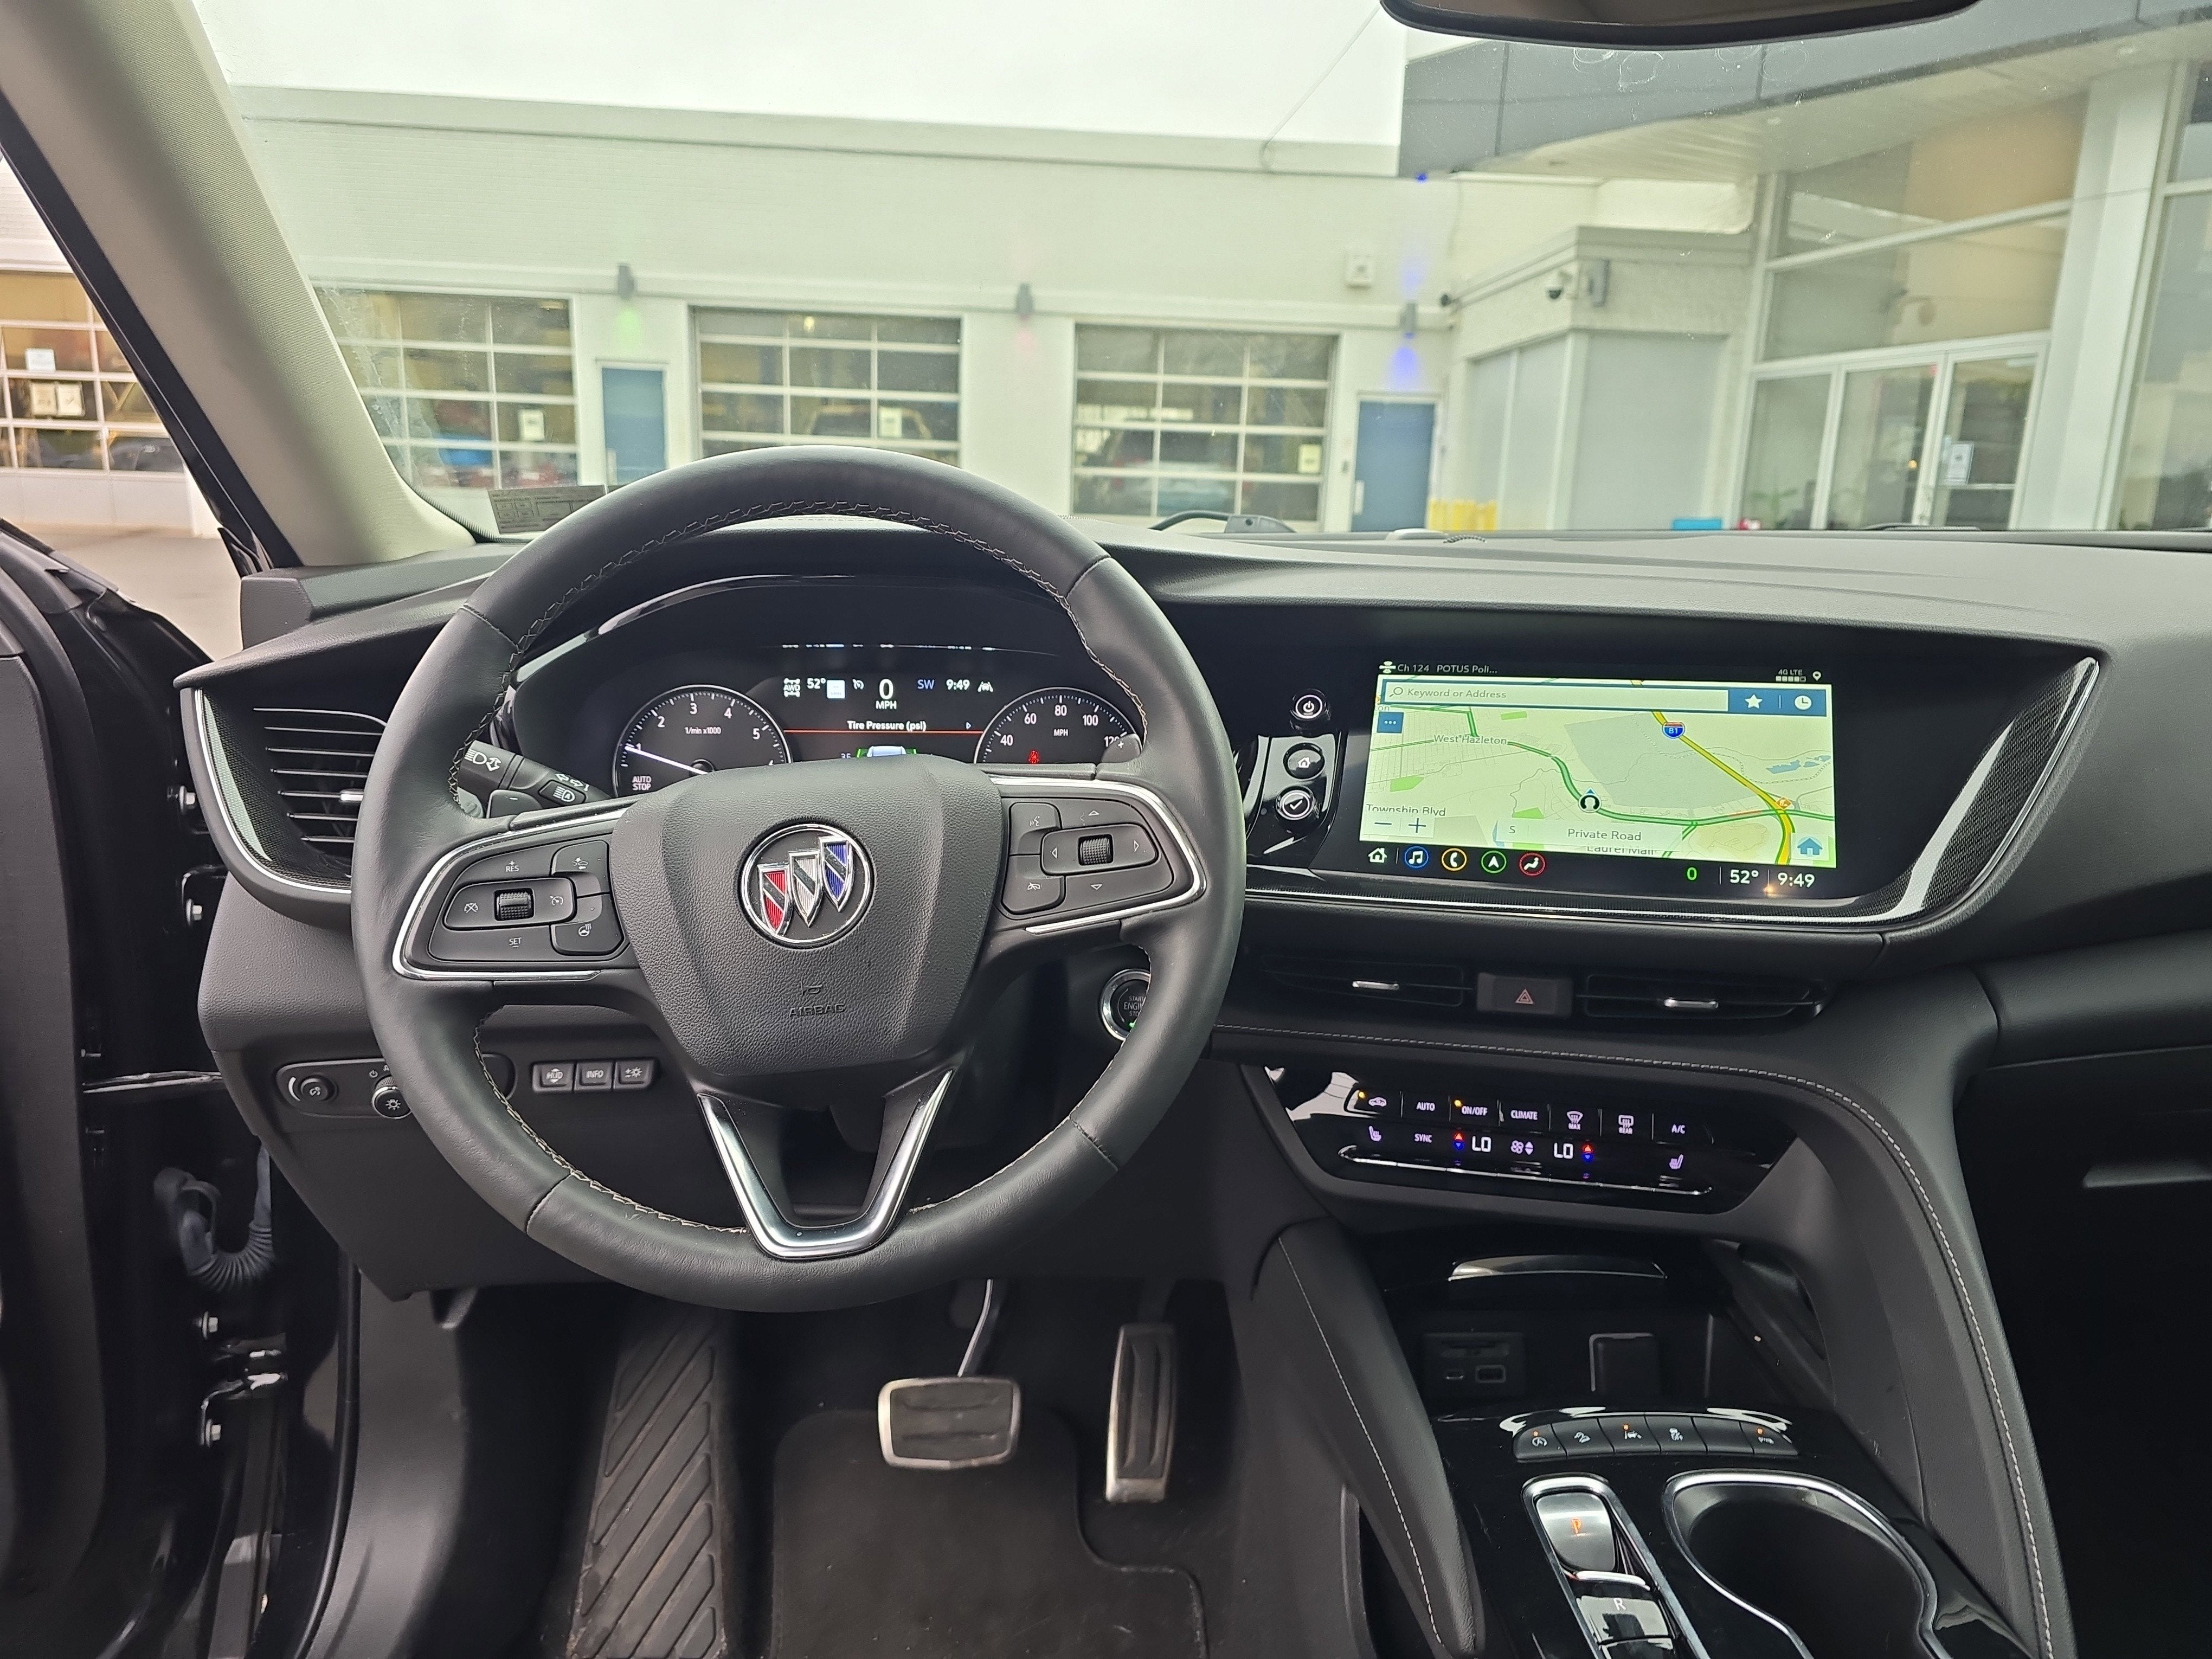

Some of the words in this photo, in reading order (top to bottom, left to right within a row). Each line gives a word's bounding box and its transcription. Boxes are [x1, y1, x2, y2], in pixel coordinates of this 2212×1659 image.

[1398, 664, 1409, 672] Ch
[1413, 664, 1430, 672] 124
[1437, 665, 1469, 673] POTUS
[879, 679, 894, 699] 0
[917, 679, 935, 690] SW
[946, 679, 970, 691] 9:49
[1407, 689, 1451, 699] Keyword
[1465, 690, 1507, 698] Address
[689, 703, 697, 715] 3
[876, 701, 897, 710] MPH
[1054, 705, 1067, 716] 80
[724, 708, 732, 719] 4
[1024, 713, 1037, 724] 60
[657, 716, 665, 728] 2
[847, 720, 865, 730] Tire
[866, 721, 905, 730] Pressure
[906, 721, 927, 732] (psi)
[1082, 715, 1099, 726] 100
[752, 728, 760, 740] 5
[1000, 734, 1013, 746] 40
[1434, 735, 1459, 743] West
[1462, 735, 1507, 745] Hazleton
[632, 776, 652, 784] AUTO
[1509, 826, 1516, 834] S
[1568, 828, 1607, 839] Private
[1611, 831, 1641, 841] Road
[1687, 867, 1697, 882] 0
[1729, 869, 1759, 884] 52°
[1777, 872, 1816, 888] 9:49
[789, 1004, 846, 1018] AIRBAG
[546, 1070, 563, 1080] HUD
[586, 1070, 604, 1078] INFO
[1416, 1102, 1436, 1111] AUTO
[1461, 1106, 1488, 1116] ON/OFF
[1510, 1110, 1538, 1121] CLIMATE
[1618, 1127, 1633, 1135] REAR
[1671, 1124, 1686, 1134] A/C
[1414, 1133, 1432, 1143] SYNC
[1471, 1135, 1491, 1152] LO
[1553, 1142, 1574, 1159] LO
[1572, 1519, 1581, 1533] P
[1613, 1599, 1626, 1611] R
